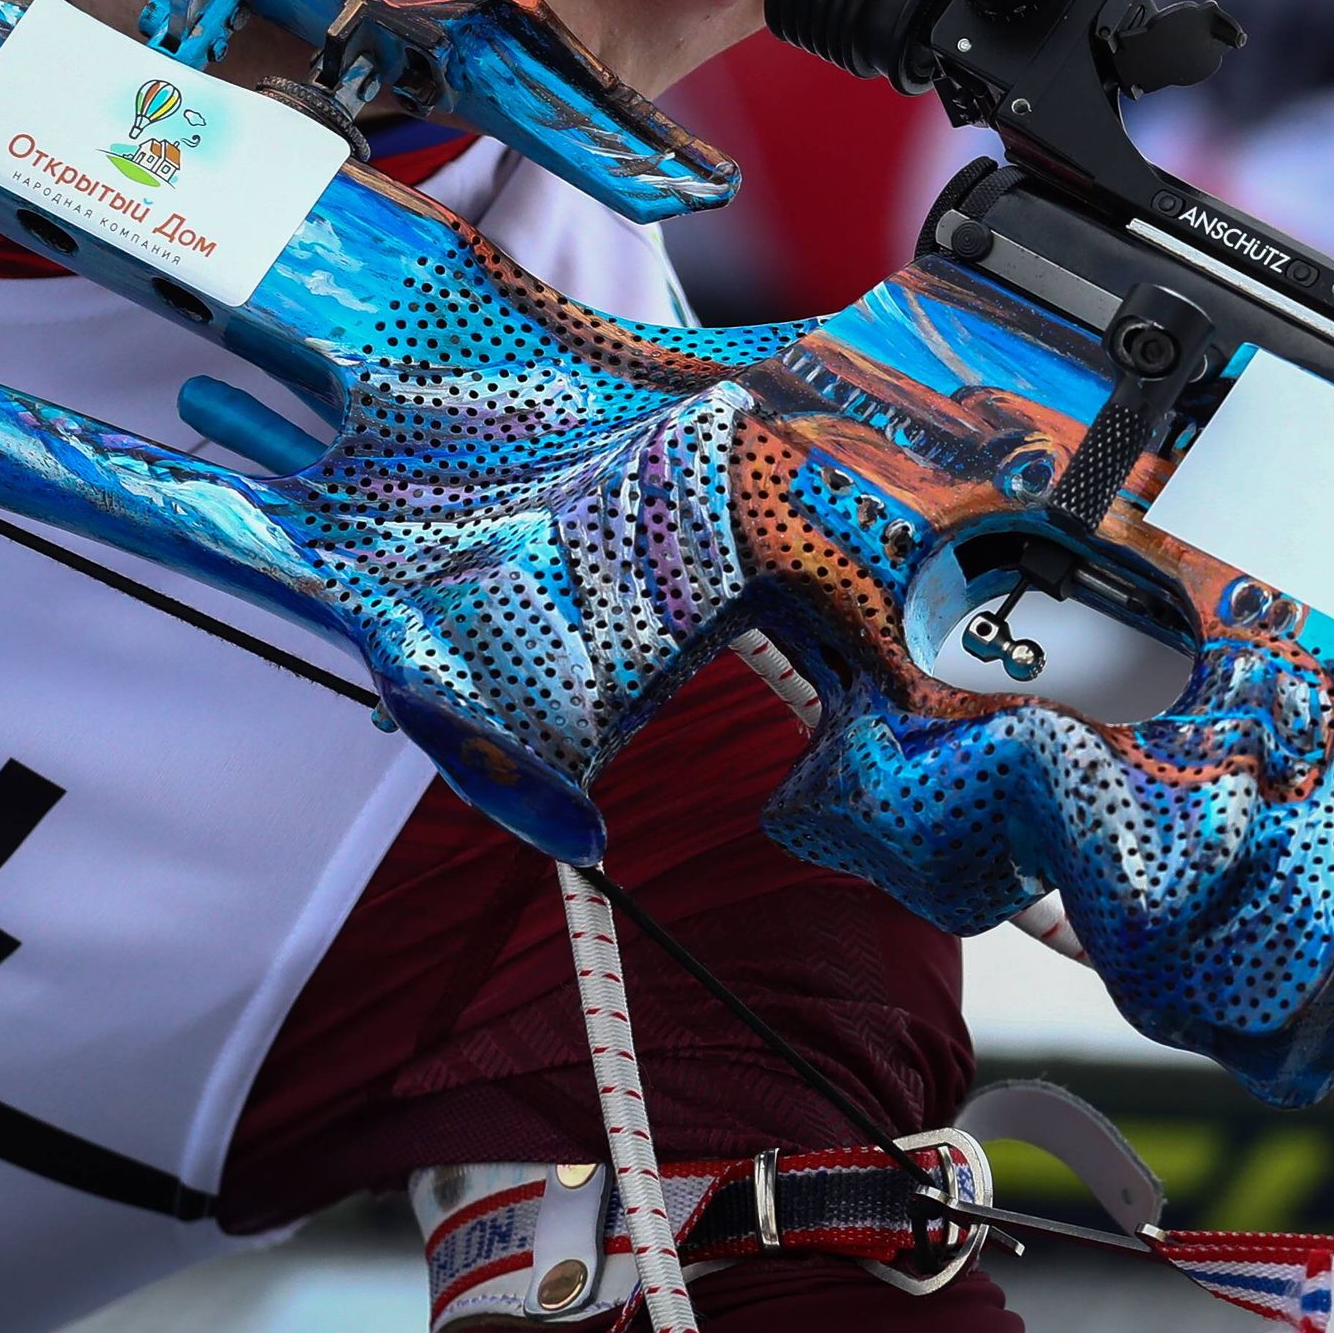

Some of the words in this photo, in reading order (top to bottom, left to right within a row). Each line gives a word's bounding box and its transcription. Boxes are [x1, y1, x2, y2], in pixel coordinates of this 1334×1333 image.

[8, 133, 154, 224] Открытый
[152, 212, 218, 258] Дом
[12, 171, 93, 219] НАРОДНАЯ
[99, 218, 181, 266] КОМПАНИЯ
